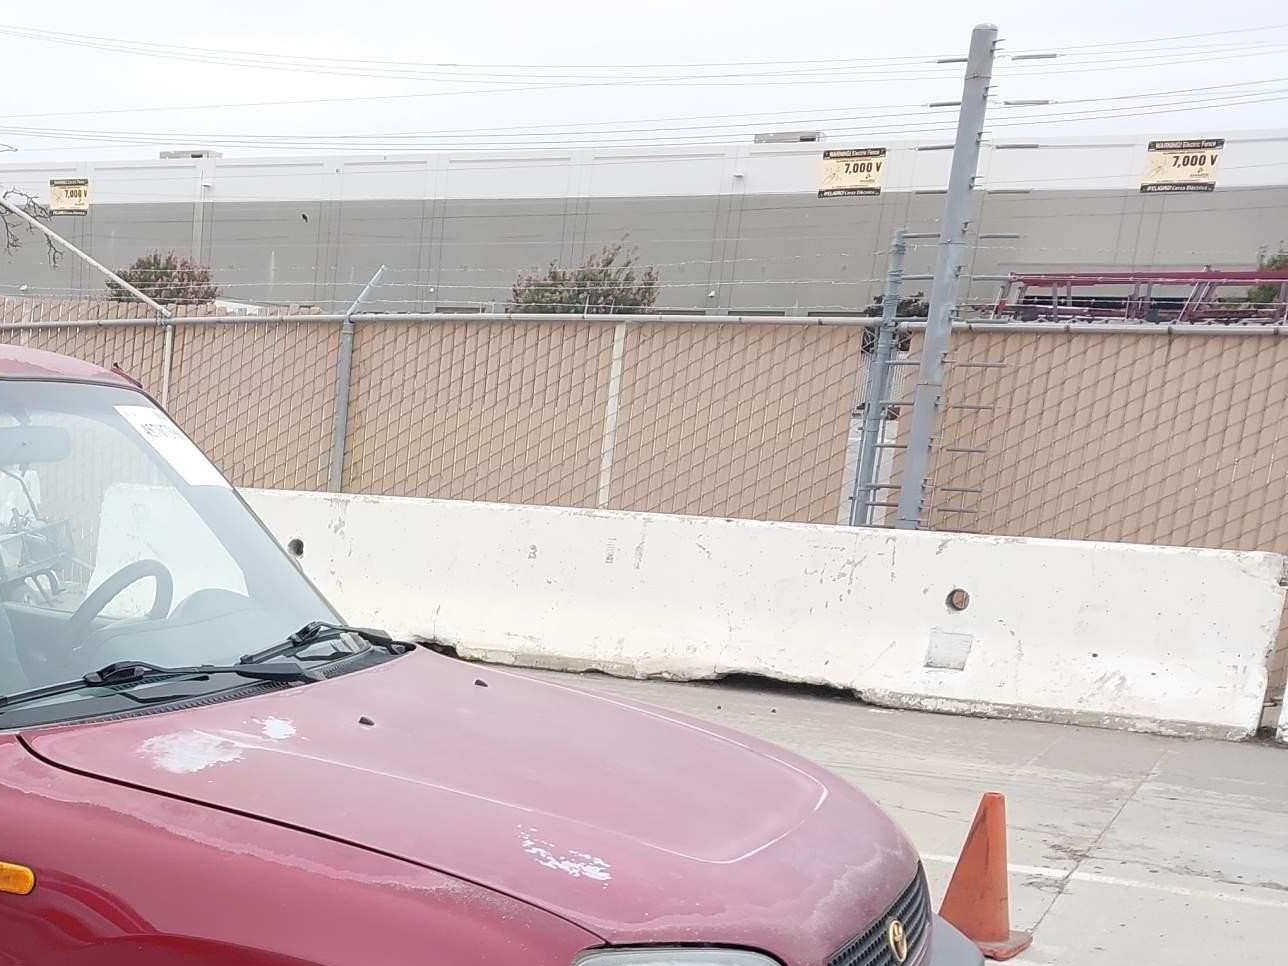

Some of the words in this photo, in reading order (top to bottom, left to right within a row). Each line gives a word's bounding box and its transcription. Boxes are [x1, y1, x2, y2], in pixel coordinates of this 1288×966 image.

[844, 162, 873, 175] 7,000
[876, 161, 882, 172] V
[1172, 155, 1206, 168] 7,000
[1211, 154, 1218, 165] V
[64, 190, 82, 199] 7,000
